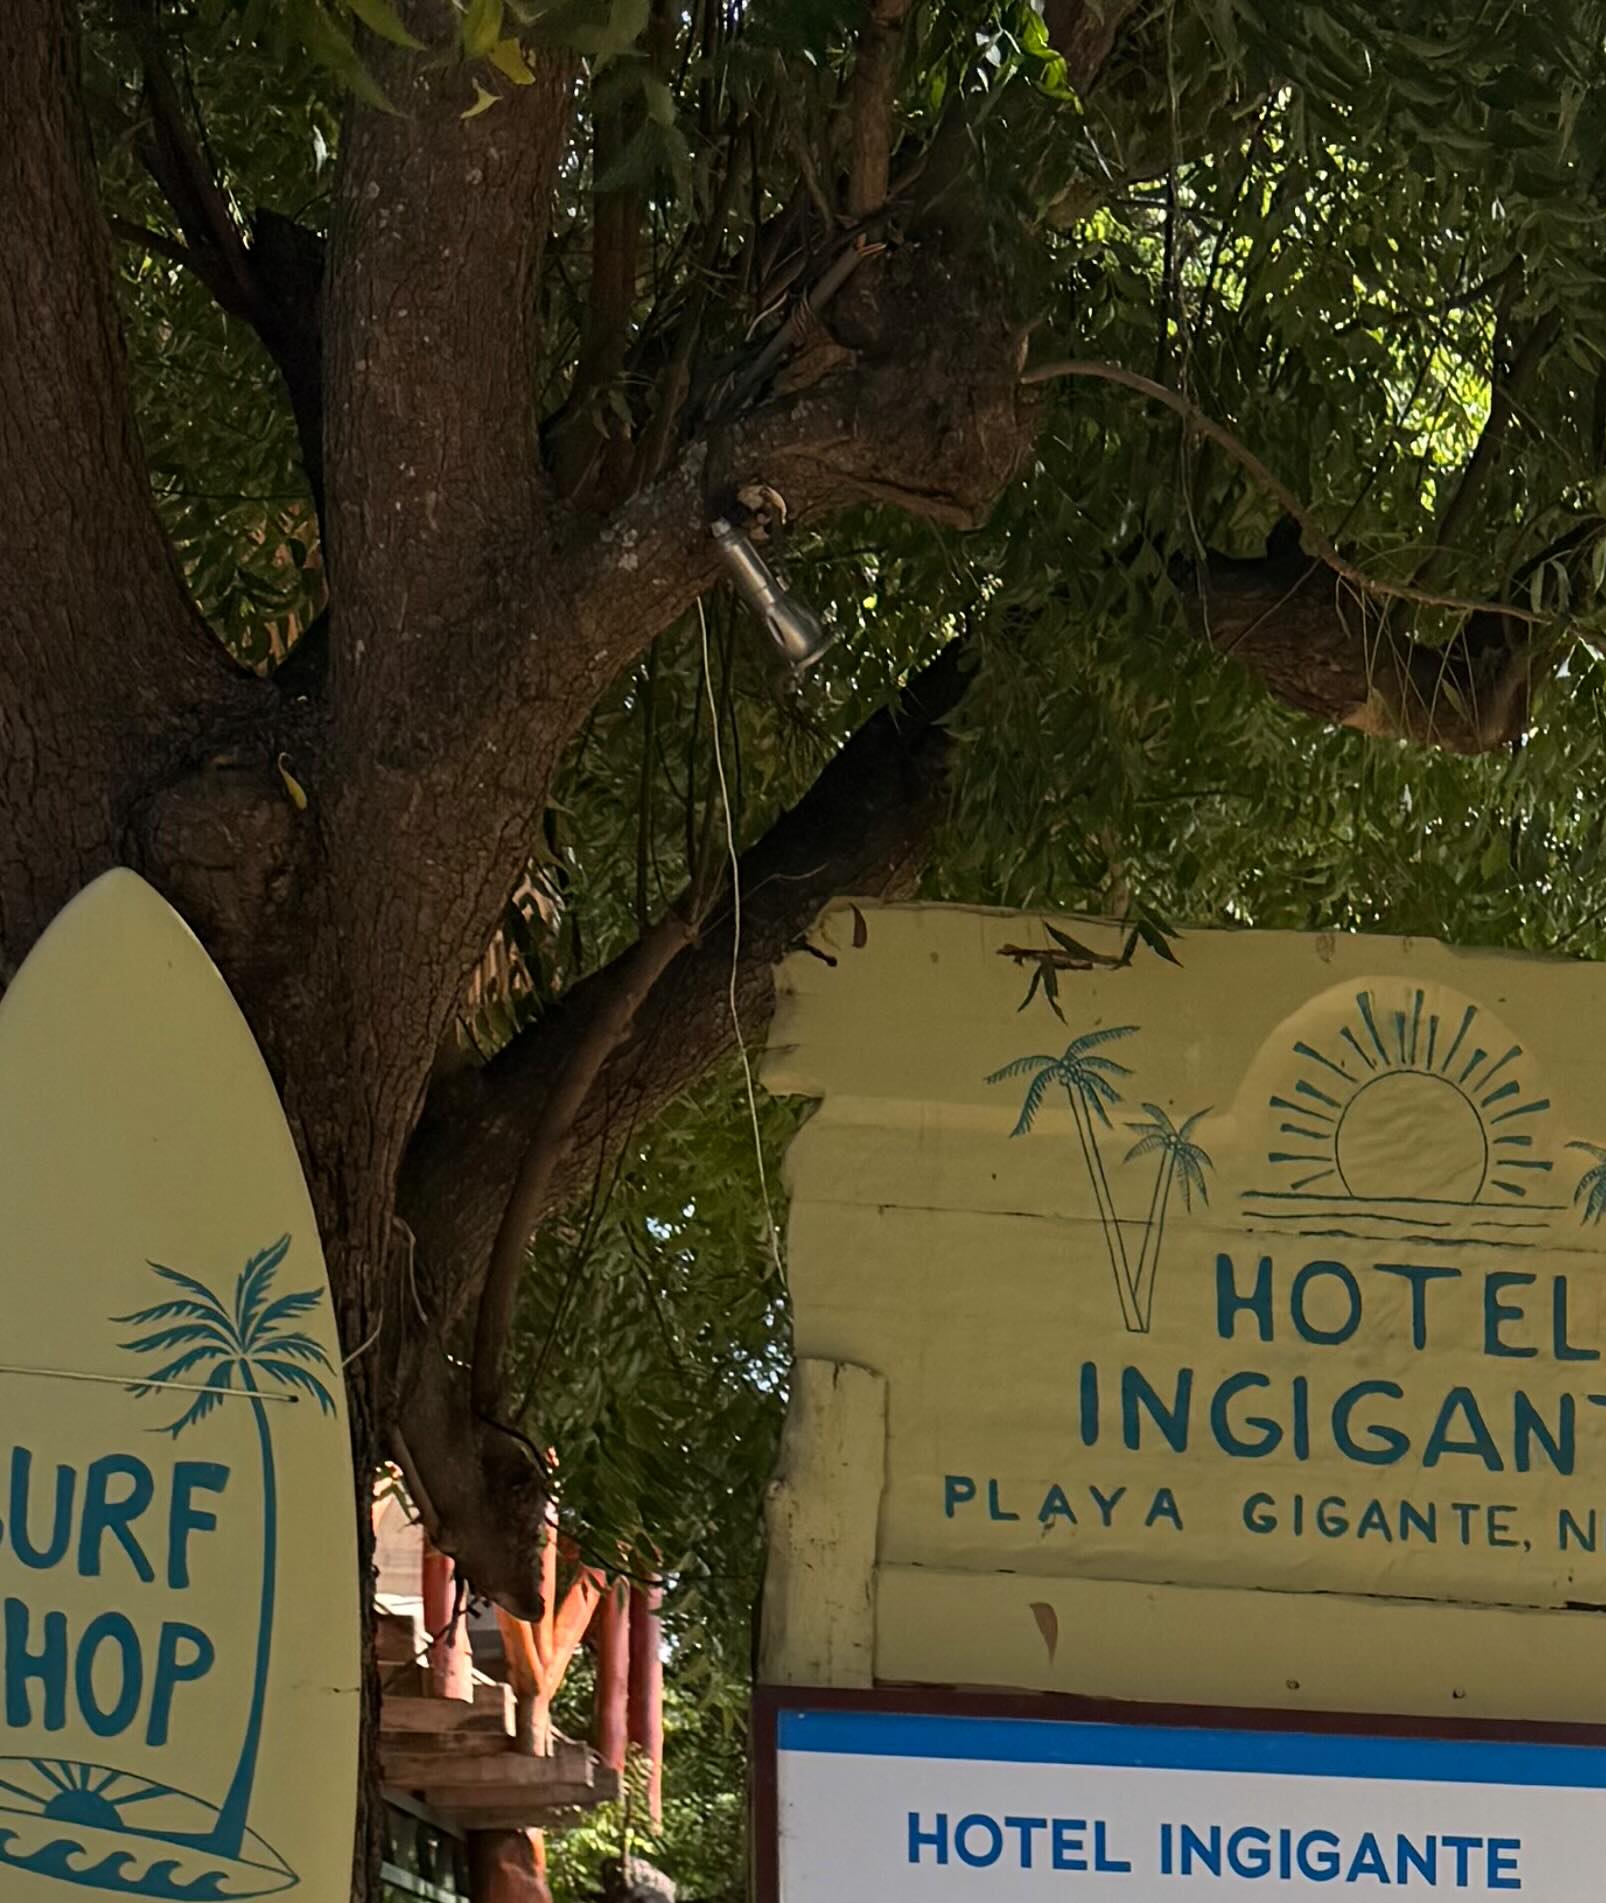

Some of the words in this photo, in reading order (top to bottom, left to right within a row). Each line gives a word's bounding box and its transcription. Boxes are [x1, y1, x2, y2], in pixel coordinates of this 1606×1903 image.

[1214, 1252, 1600, 1363] HOTEL
[0, 1445, 231, 1590] URF
[944, 1474, 1184, 1533] PLAYA
[1242, 1492, 1532, 1555] GIGANTE,
[907, 1811, 1132, 1874] HOTEL
[1160, 1822, 1523, 1890] INGIGANTE
